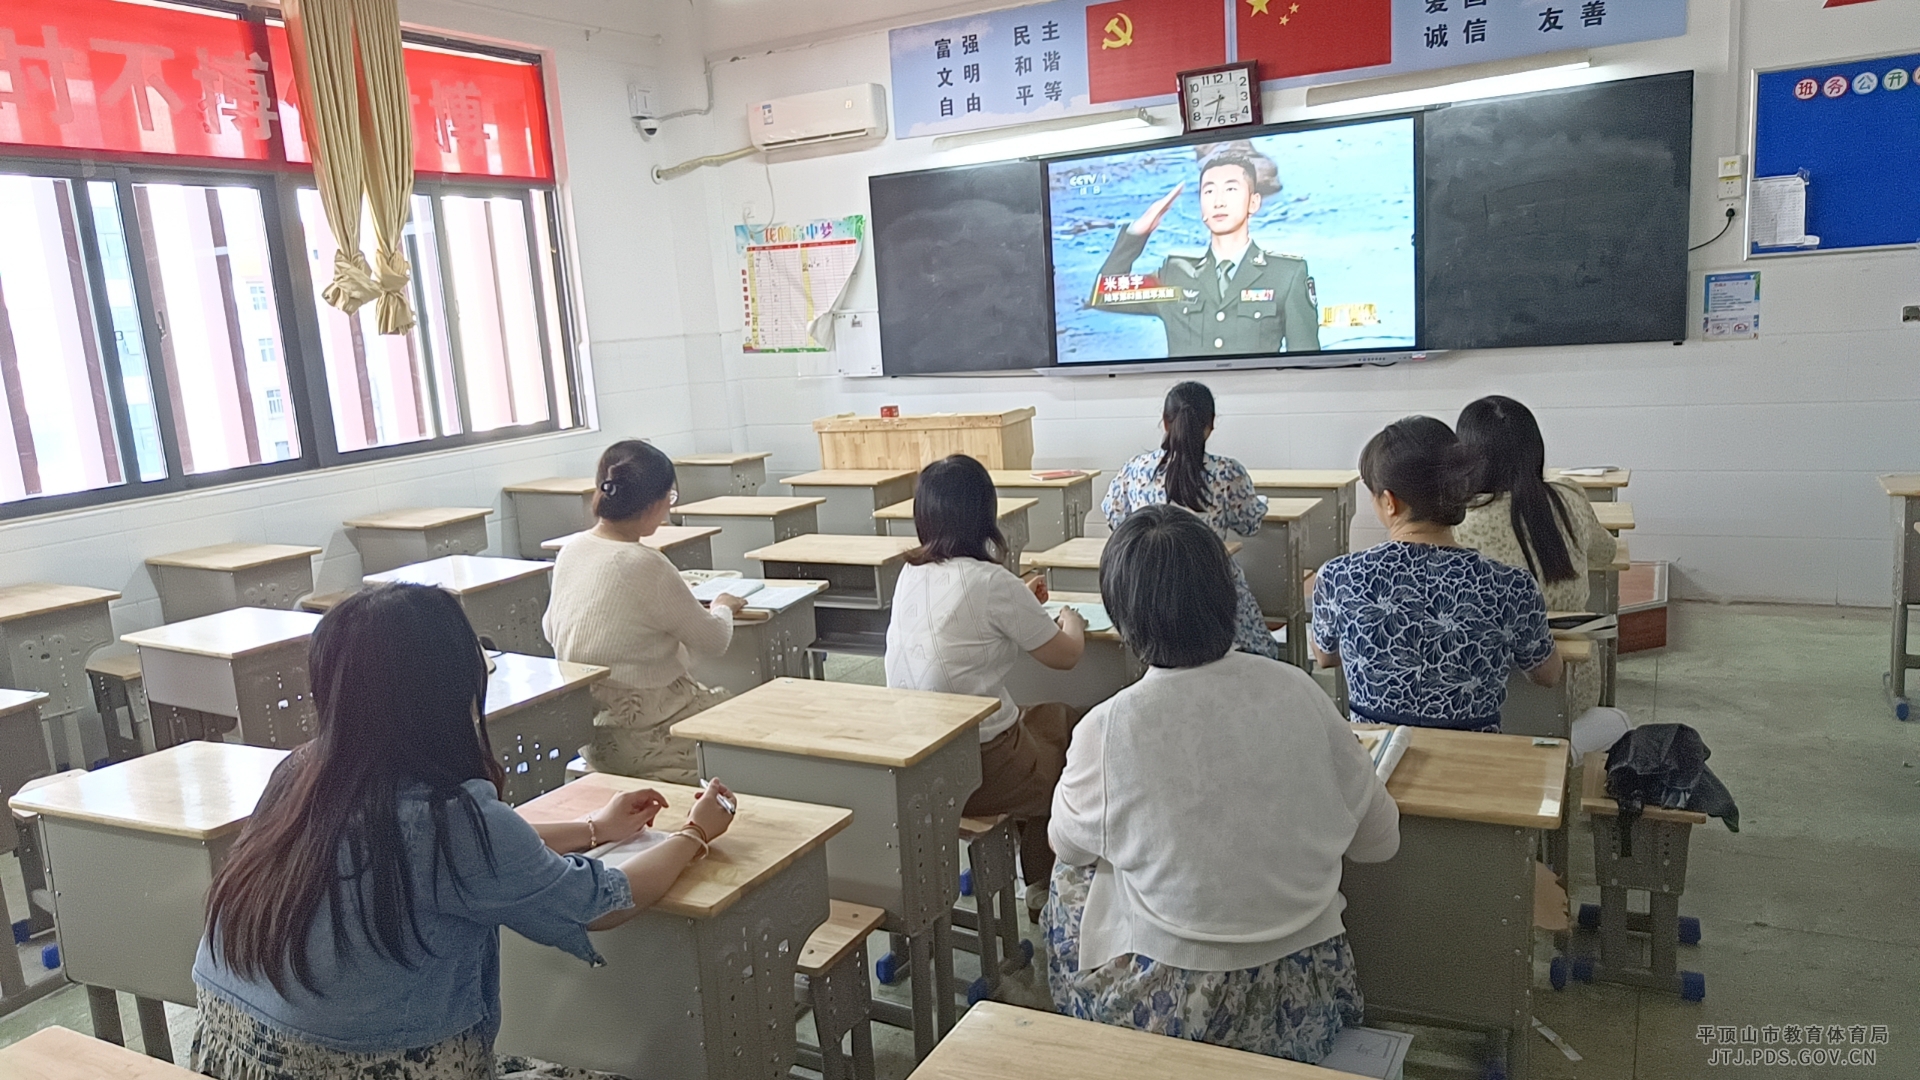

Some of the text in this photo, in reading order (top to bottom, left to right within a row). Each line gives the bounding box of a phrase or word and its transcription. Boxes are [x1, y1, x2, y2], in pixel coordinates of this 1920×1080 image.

[1424, 1, 1606, 49] 诚信 友善
[934, 20, 1061, 60] 富强 民主
[937, 51, 1062, 88] 文明 和谐
[1202, 75, 1210, 86] 11
[1212, 73, 1223, 84] 12
[1229, 72, 1232, 82] 1
[1239, 76, 1247, 87] 2
[1189, 83, 1199, 93] 10
[1798, 70, 1920, 97] 班务公开
[939, 80, 1063, 118] 自由 平等
[1240, 91, 1248, 101] 3
[1191, 97, 1200, 108] 9
[1241, 105, 1249, 114] 4
[1193, 111, 1201, 122] 8
[1205, 116, 1213, 126] 7
[1217, 115, 1226, 125] 6
[1229, 113, 1238, 123] 5
[1069, 173, 1097, 187] CCTV
